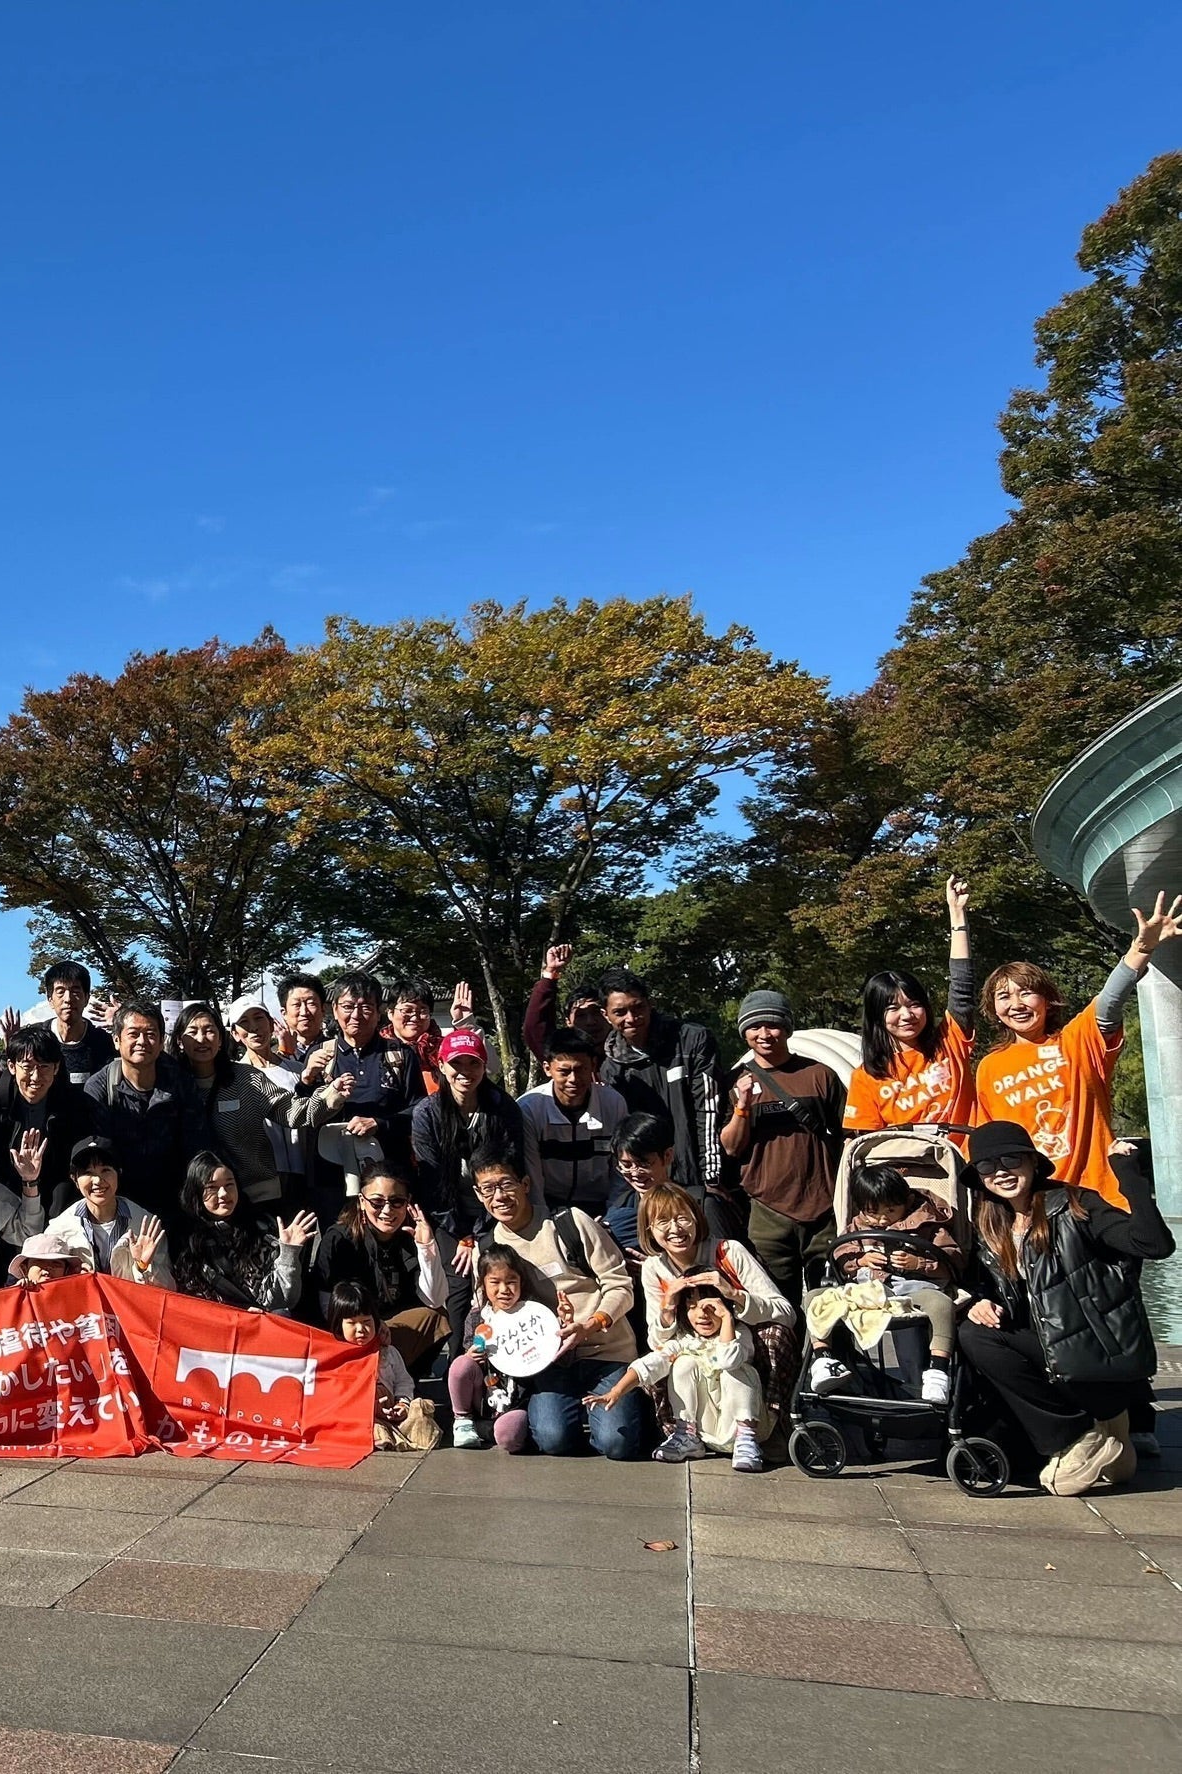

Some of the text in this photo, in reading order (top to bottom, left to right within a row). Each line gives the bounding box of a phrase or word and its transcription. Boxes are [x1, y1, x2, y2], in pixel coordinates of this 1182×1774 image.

[993, 1057, 1068, 1095] ORANGE
[1004, 1075, 1065, 1107] WALK
[497, 1314, 541, 1351] なんとか
